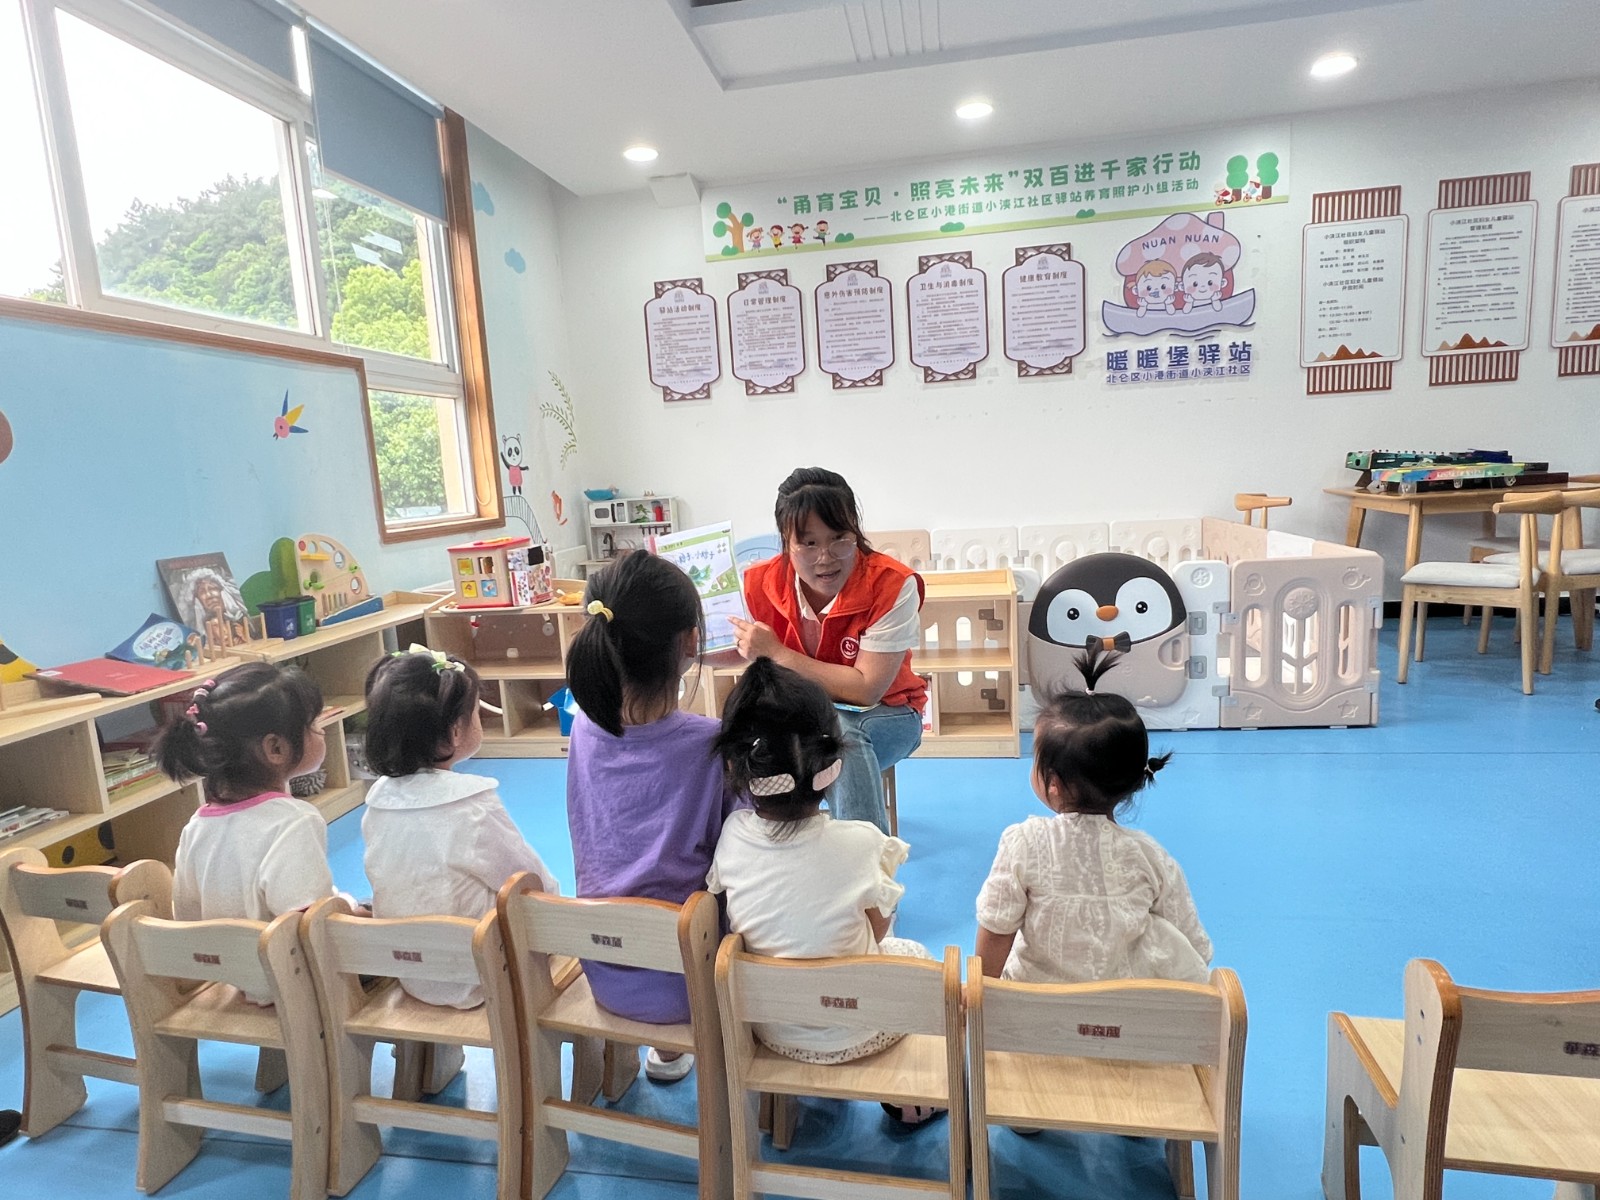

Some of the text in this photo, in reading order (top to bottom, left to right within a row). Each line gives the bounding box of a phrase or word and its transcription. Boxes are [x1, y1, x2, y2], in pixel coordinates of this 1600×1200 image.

[1142, 234, 1220, 250] NUAN NUAN
[1020, 271, 1068, 283] 健康教育制度
[920, 278, 974, 291] 卫生与消毒制度
[743, 296, 786, 307] 日常管理制度
[1106, 341, 1252, 371] 暖暖堡驿站
